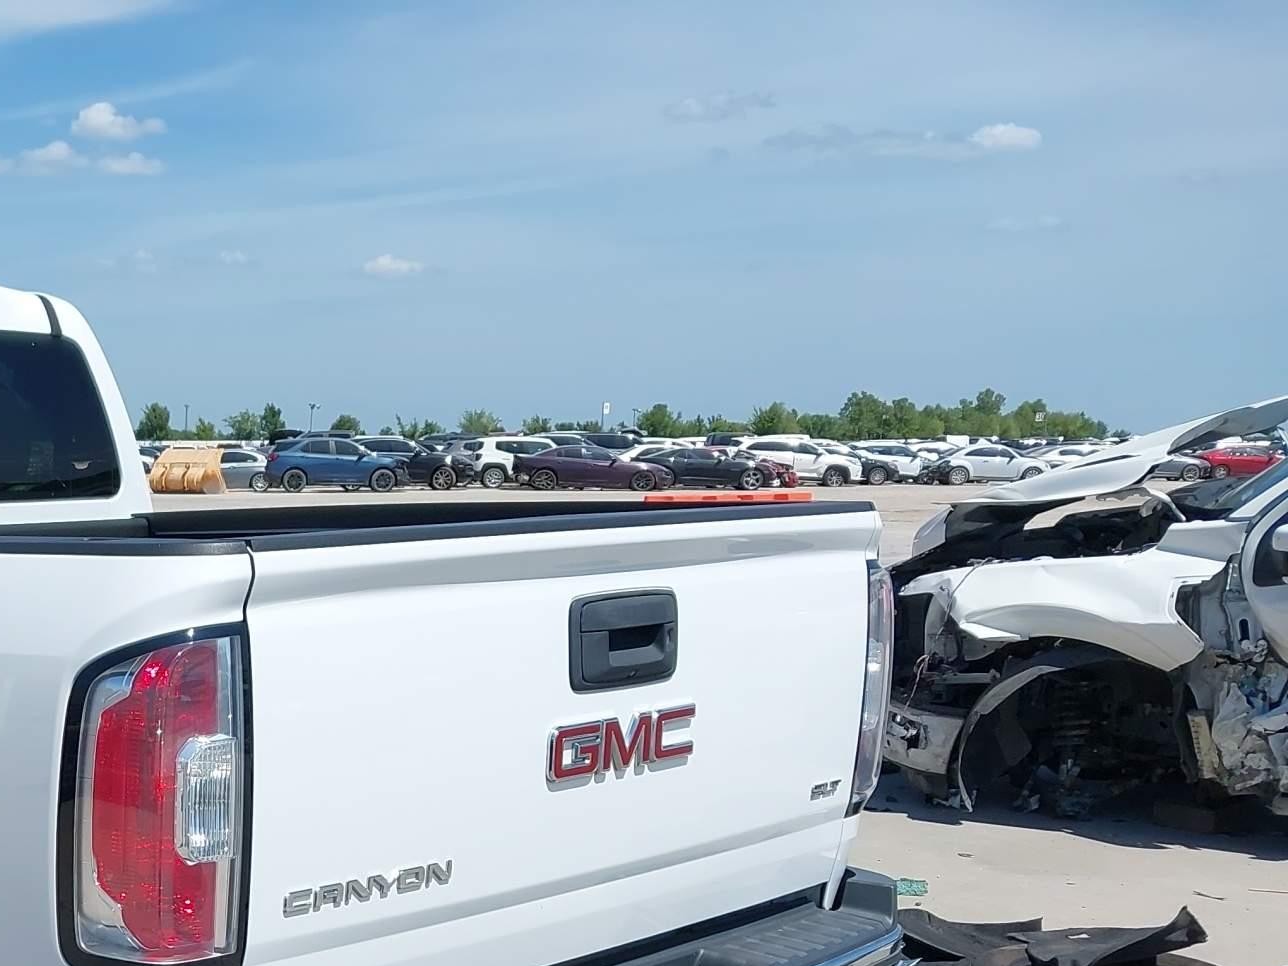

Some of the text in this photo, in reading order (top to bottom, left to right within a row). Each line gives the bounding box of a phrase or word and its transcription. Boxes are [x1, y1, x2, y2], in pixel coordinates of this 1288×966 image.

[546, 703, 697, 784] GMC
[810, 779, 842, 801] SLT
[282, 859, 453, 918] CANYON
